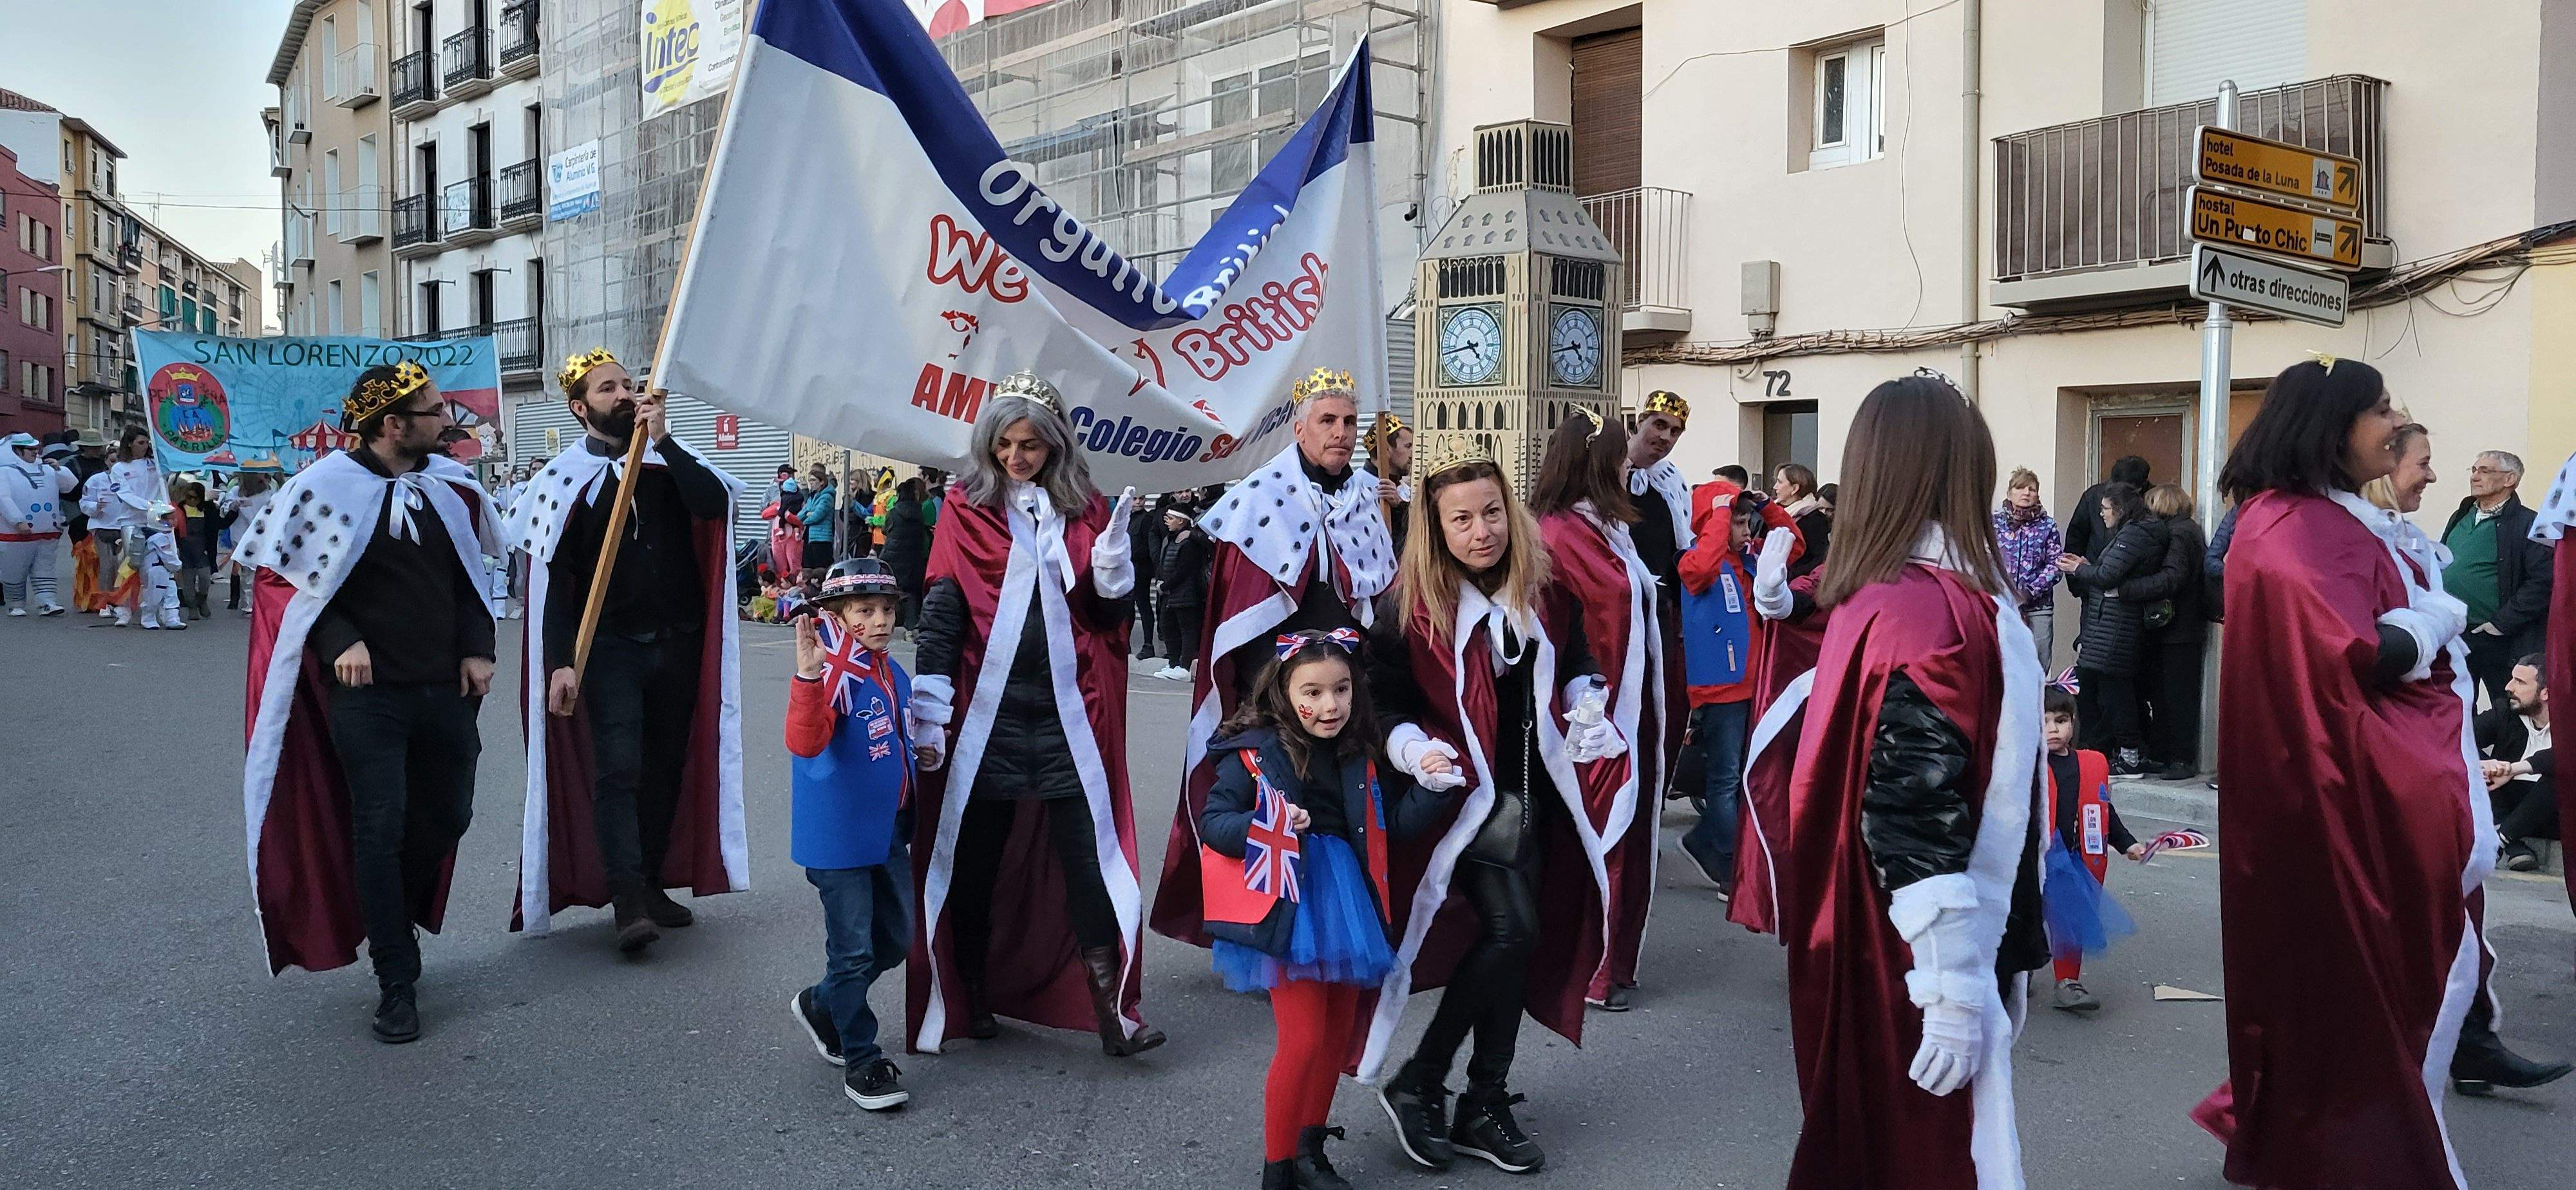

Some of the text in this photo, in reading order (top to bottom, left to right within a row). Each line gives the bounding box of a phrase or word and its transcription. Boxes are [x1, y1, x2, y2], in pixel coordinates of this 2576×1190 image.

[2206, 137, 2233, 156] hotel
[2205, 157, 2300, 189] Posada de la Luna
[2199, 195, 2235, 216] hostal
[2198, 212, 2219, 236] Un
[2275, 228, 2307, 252] Chic
[927, 214, 1029, 303] We
[2230, 270, 2342, 312] otras direcciones
[194, 340, 473, 368] SAN LORENZO 2022
[1763, 370, 1791, 397] 72
[1070, 406, 1203, 463] Colegio
